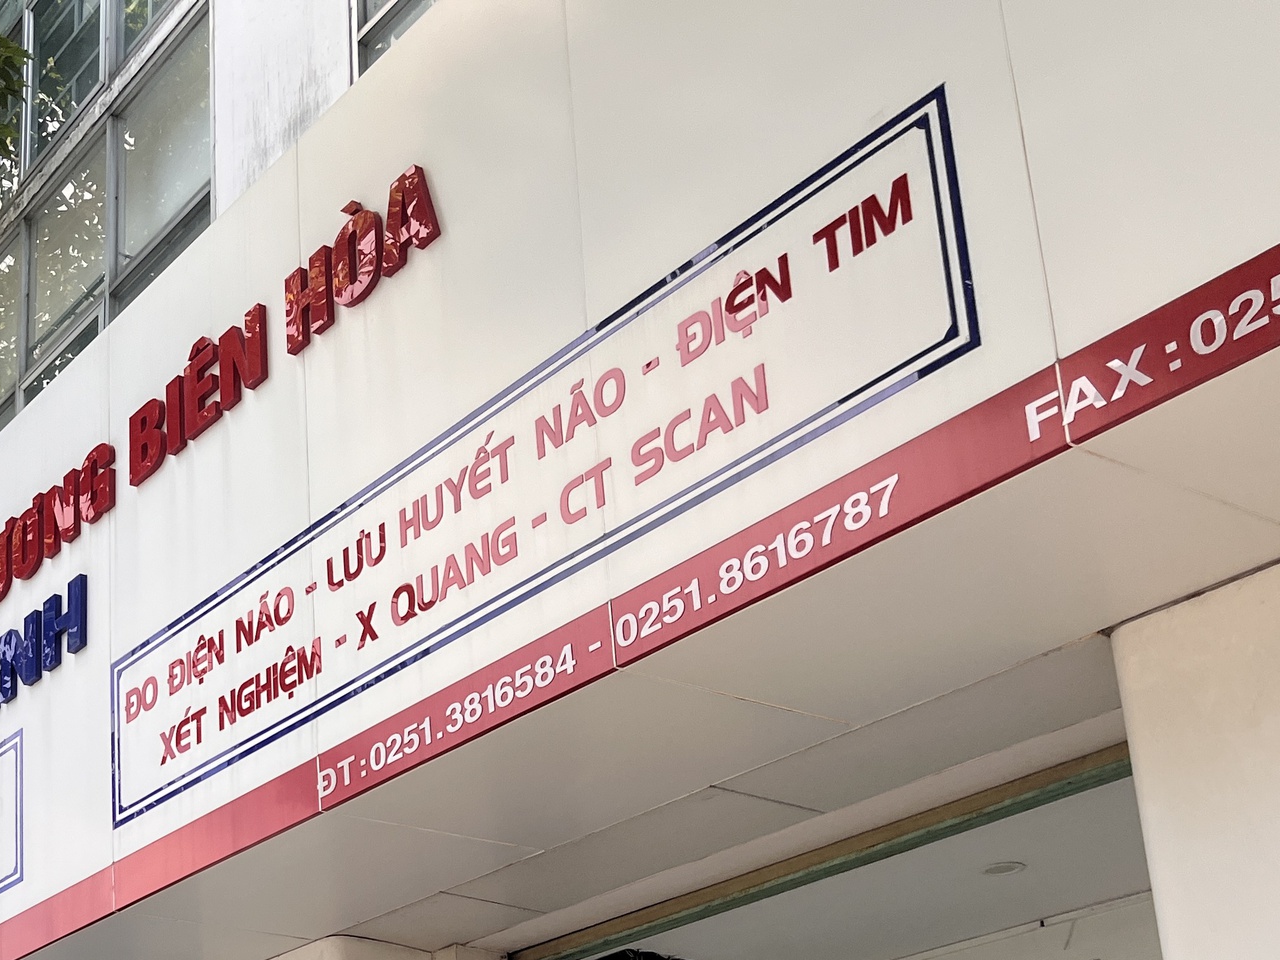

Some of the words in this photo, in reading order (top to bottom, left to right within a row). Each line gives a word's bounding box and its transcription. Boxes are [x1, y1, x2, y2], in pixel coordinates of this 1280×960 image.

[124, 676, 159, 725] ĐO
[167, 630, 225, 697] ĐIỆN
[235, 585, 296, 655] NÃO
[326, 521, 387, 592] LƯU
[399, 430, 515, 549] HUYẾT
[534, 367, 626, 461] NÃO
[675, 252, 793, 367] ĐIỆN
[812, 172, 914, 273] TIM
[129, 303, 269, 487] BIÊN
[285, 164, 441, 356] HÒA
[160, 706, 208, 767] XÉT
[218, 636, 323, 731] NGHIỆM
[356, 602, 379, 652] X
[390, 516, 518, 627] QUANG
[559, 457, 613, 526] CT
[629, 363, 770, 487] SCAN
[615, 473, 901, 648] 0251.8616787
